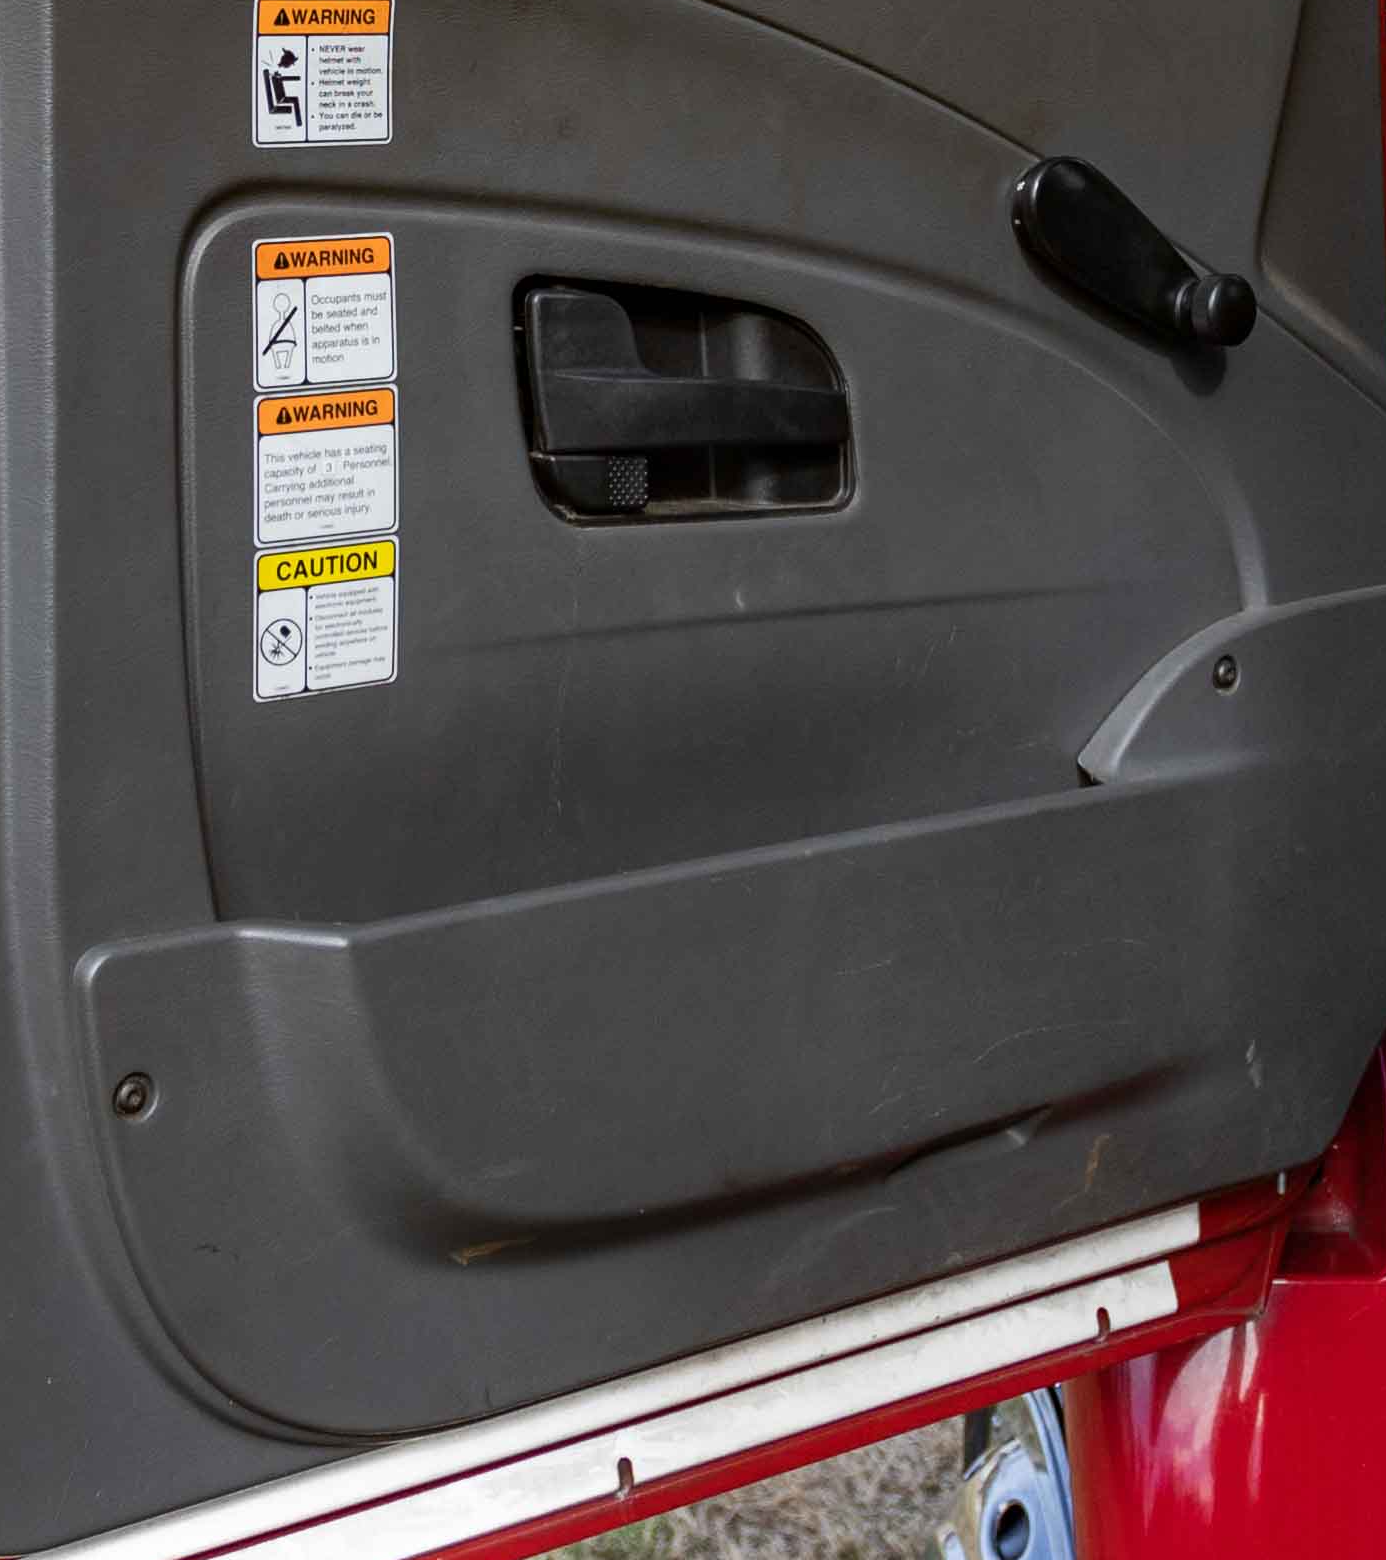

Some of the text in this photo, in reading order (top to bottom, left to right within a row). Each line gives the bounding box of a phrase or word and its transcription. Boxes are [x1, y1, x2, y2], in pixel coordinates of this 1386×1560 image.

[292, 8, 375, 25] WARNING
[347, 79, 370, 87] weight
[357, 90, 373, 98] your
[291, 248, 374, 267] WARNING
[311, 291, 387, 305] Occupants must
[311, 306, 378, 319] be seated and
[311, 321, 368, 334] belted when
[311, 336, 380, 350] apparatus is in
[293, 400, 378, 422] WARNING
[265, 453, 285, 464] This
[287, 450, 322, 462] vehicle
[324, 448, 342, 459] has
[353, 443, 387, 457] seating
[264, 465, 304, 479] capacity
[307, 465, 317, 474] of
[326, 463, 332, 473] 3
[264, 477, 355, 495] Carrying additional
[264, 488, 375, 510] personnel may result in
[264, 510, 292, 523] death
[294, 510, 304, 520] or
[307, 506, 342, 518] serious
[276, 551, 378, 582] CAUTION
